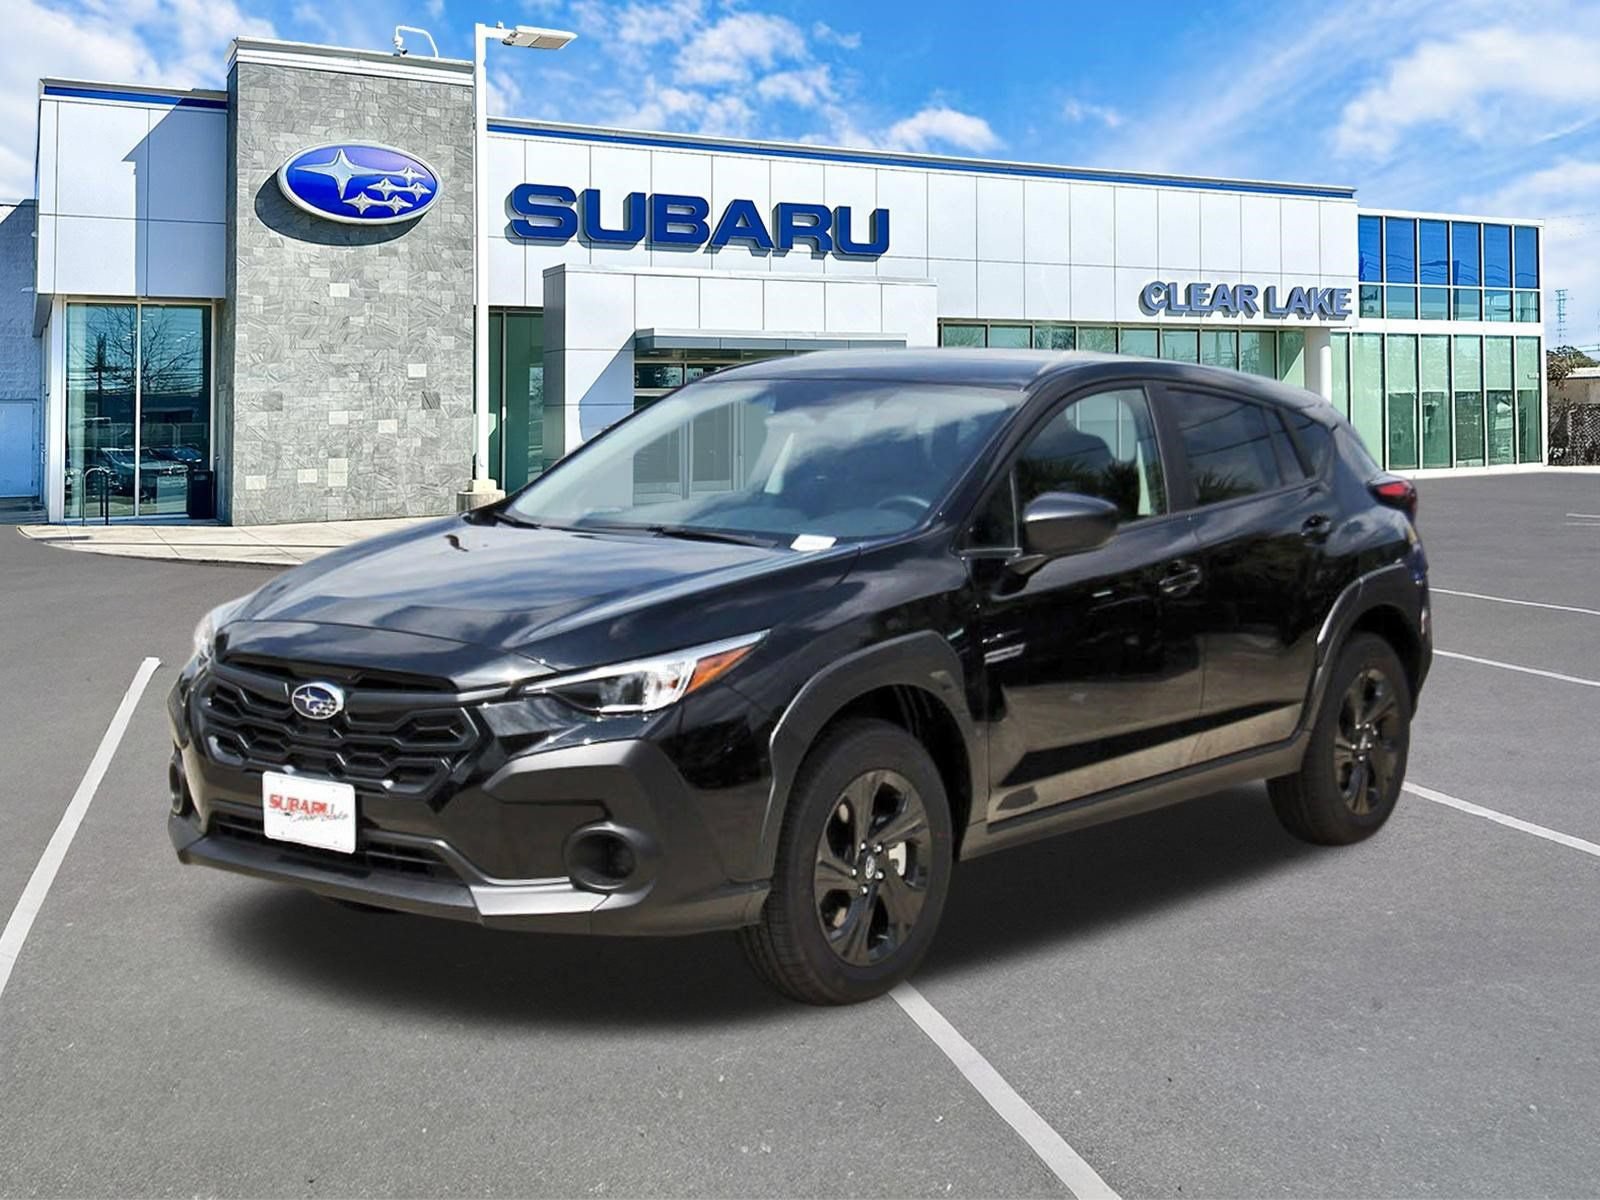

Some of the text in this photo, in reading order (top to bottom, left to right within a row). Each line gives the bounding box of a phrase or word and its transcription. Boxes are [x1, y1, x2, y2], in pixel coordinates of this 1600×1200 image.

[506, 183, 890, 260] SUBARU
[1140, 281, 1352, 319] CLEAR LAKE
